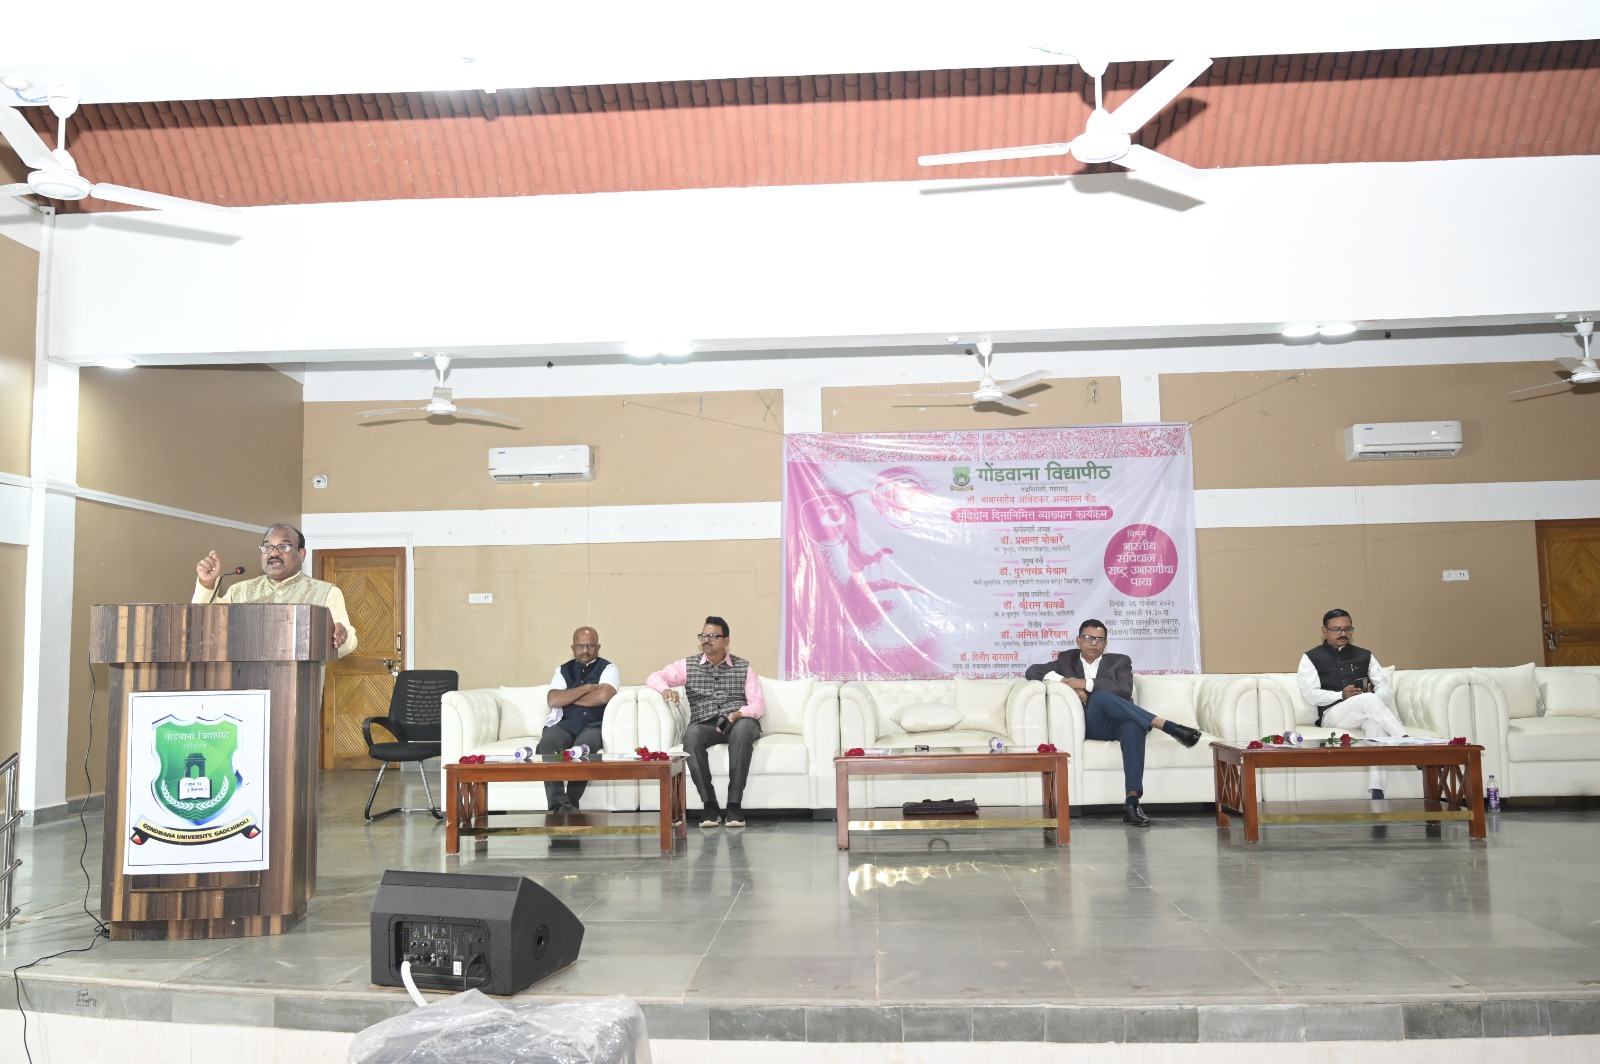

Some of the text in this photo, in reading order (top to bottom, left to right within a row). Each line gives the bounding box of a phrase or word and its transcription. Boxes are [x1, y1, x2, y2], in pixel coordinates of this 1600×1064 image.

[976, 460, 1112, 482] गोंडवाना विद्यापीठ
[980, 494, 1015, 504] बाबासाहेब
[1018, 494, 1049, 504] आंबेडकर
[1052, 494, 1082, 503] अध्यासन
[956, 506, 1107, 522] संविधान दिनानिमित्त व्याख्यान कार्यक्रम
[1127, 529, 1146, 537] विषय
[1000, 534, 1064, 545] डॉ. प्रशान्त बोकारे
[1123, 539, 1156, 550] भारतीय
[1116, 552, 1156, 562] संविधान
[999, 565, 1067, 578] डॉ. पुरणचंद्र मेश्राम
[1108, 562, 1174, 578] राष्ट्र उभारणीचा
[1130, 578, 1152, 586] पाया
[1003, 599, 1065, 610] डॉ. श्रीराम कावळे
[1001, 629, 1068, 639] डॉ. अनिल हिरेखण
[960, 652, 970, 661] डॉ.
[972, 652, 990, 662] दिलीप
[164, 730, 230, 741] गोंडवाना विद्यापीठ
[142, 823, 176, 839] GONDWANA
[214, 818, 249, 837] GADCHIROLI
